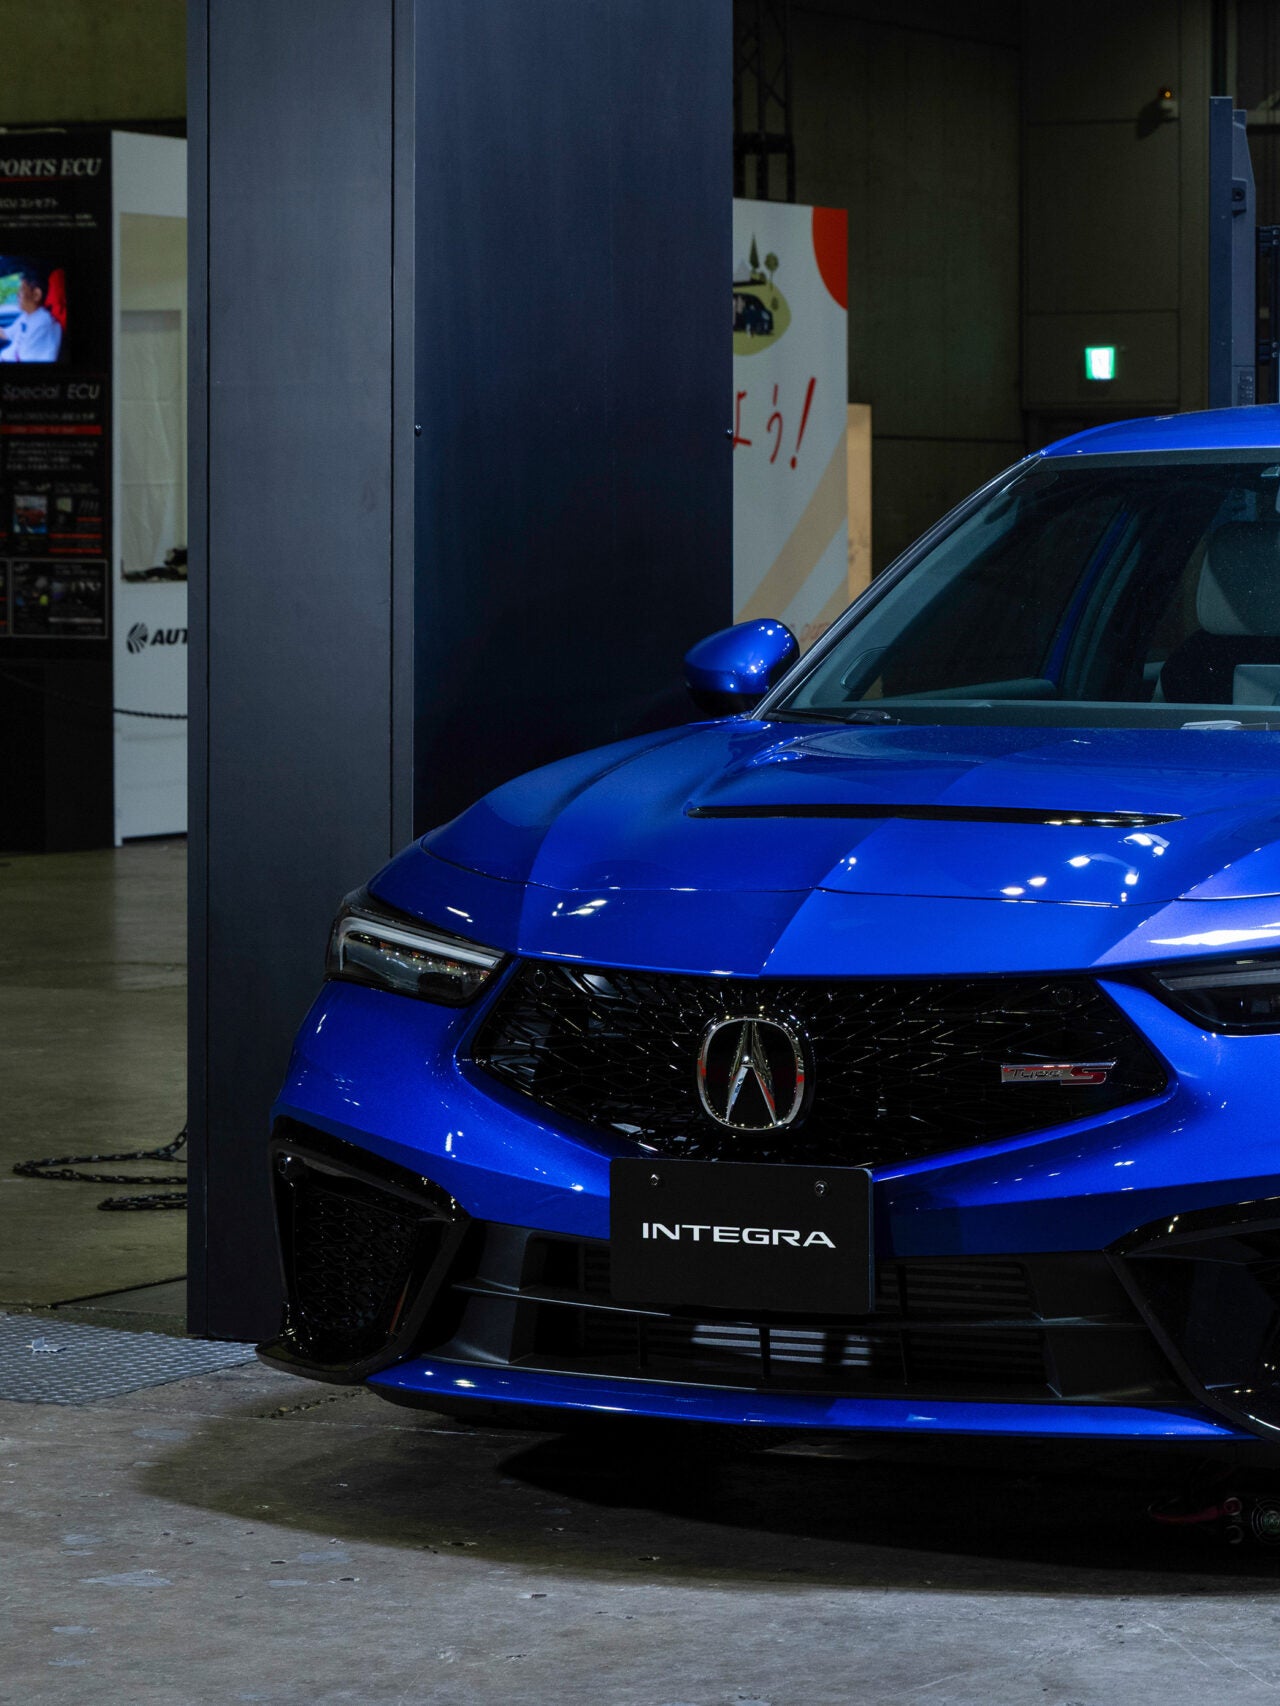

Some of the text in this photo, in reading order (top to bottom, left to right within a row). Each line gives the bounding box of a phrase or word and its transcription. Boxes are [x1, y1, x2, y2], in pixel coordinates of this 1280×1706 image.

[60, 157, 102, 176] ECU
[67, 383, 100, 399] ECU
[642, 1221, 837, 1249] INTEGRA
